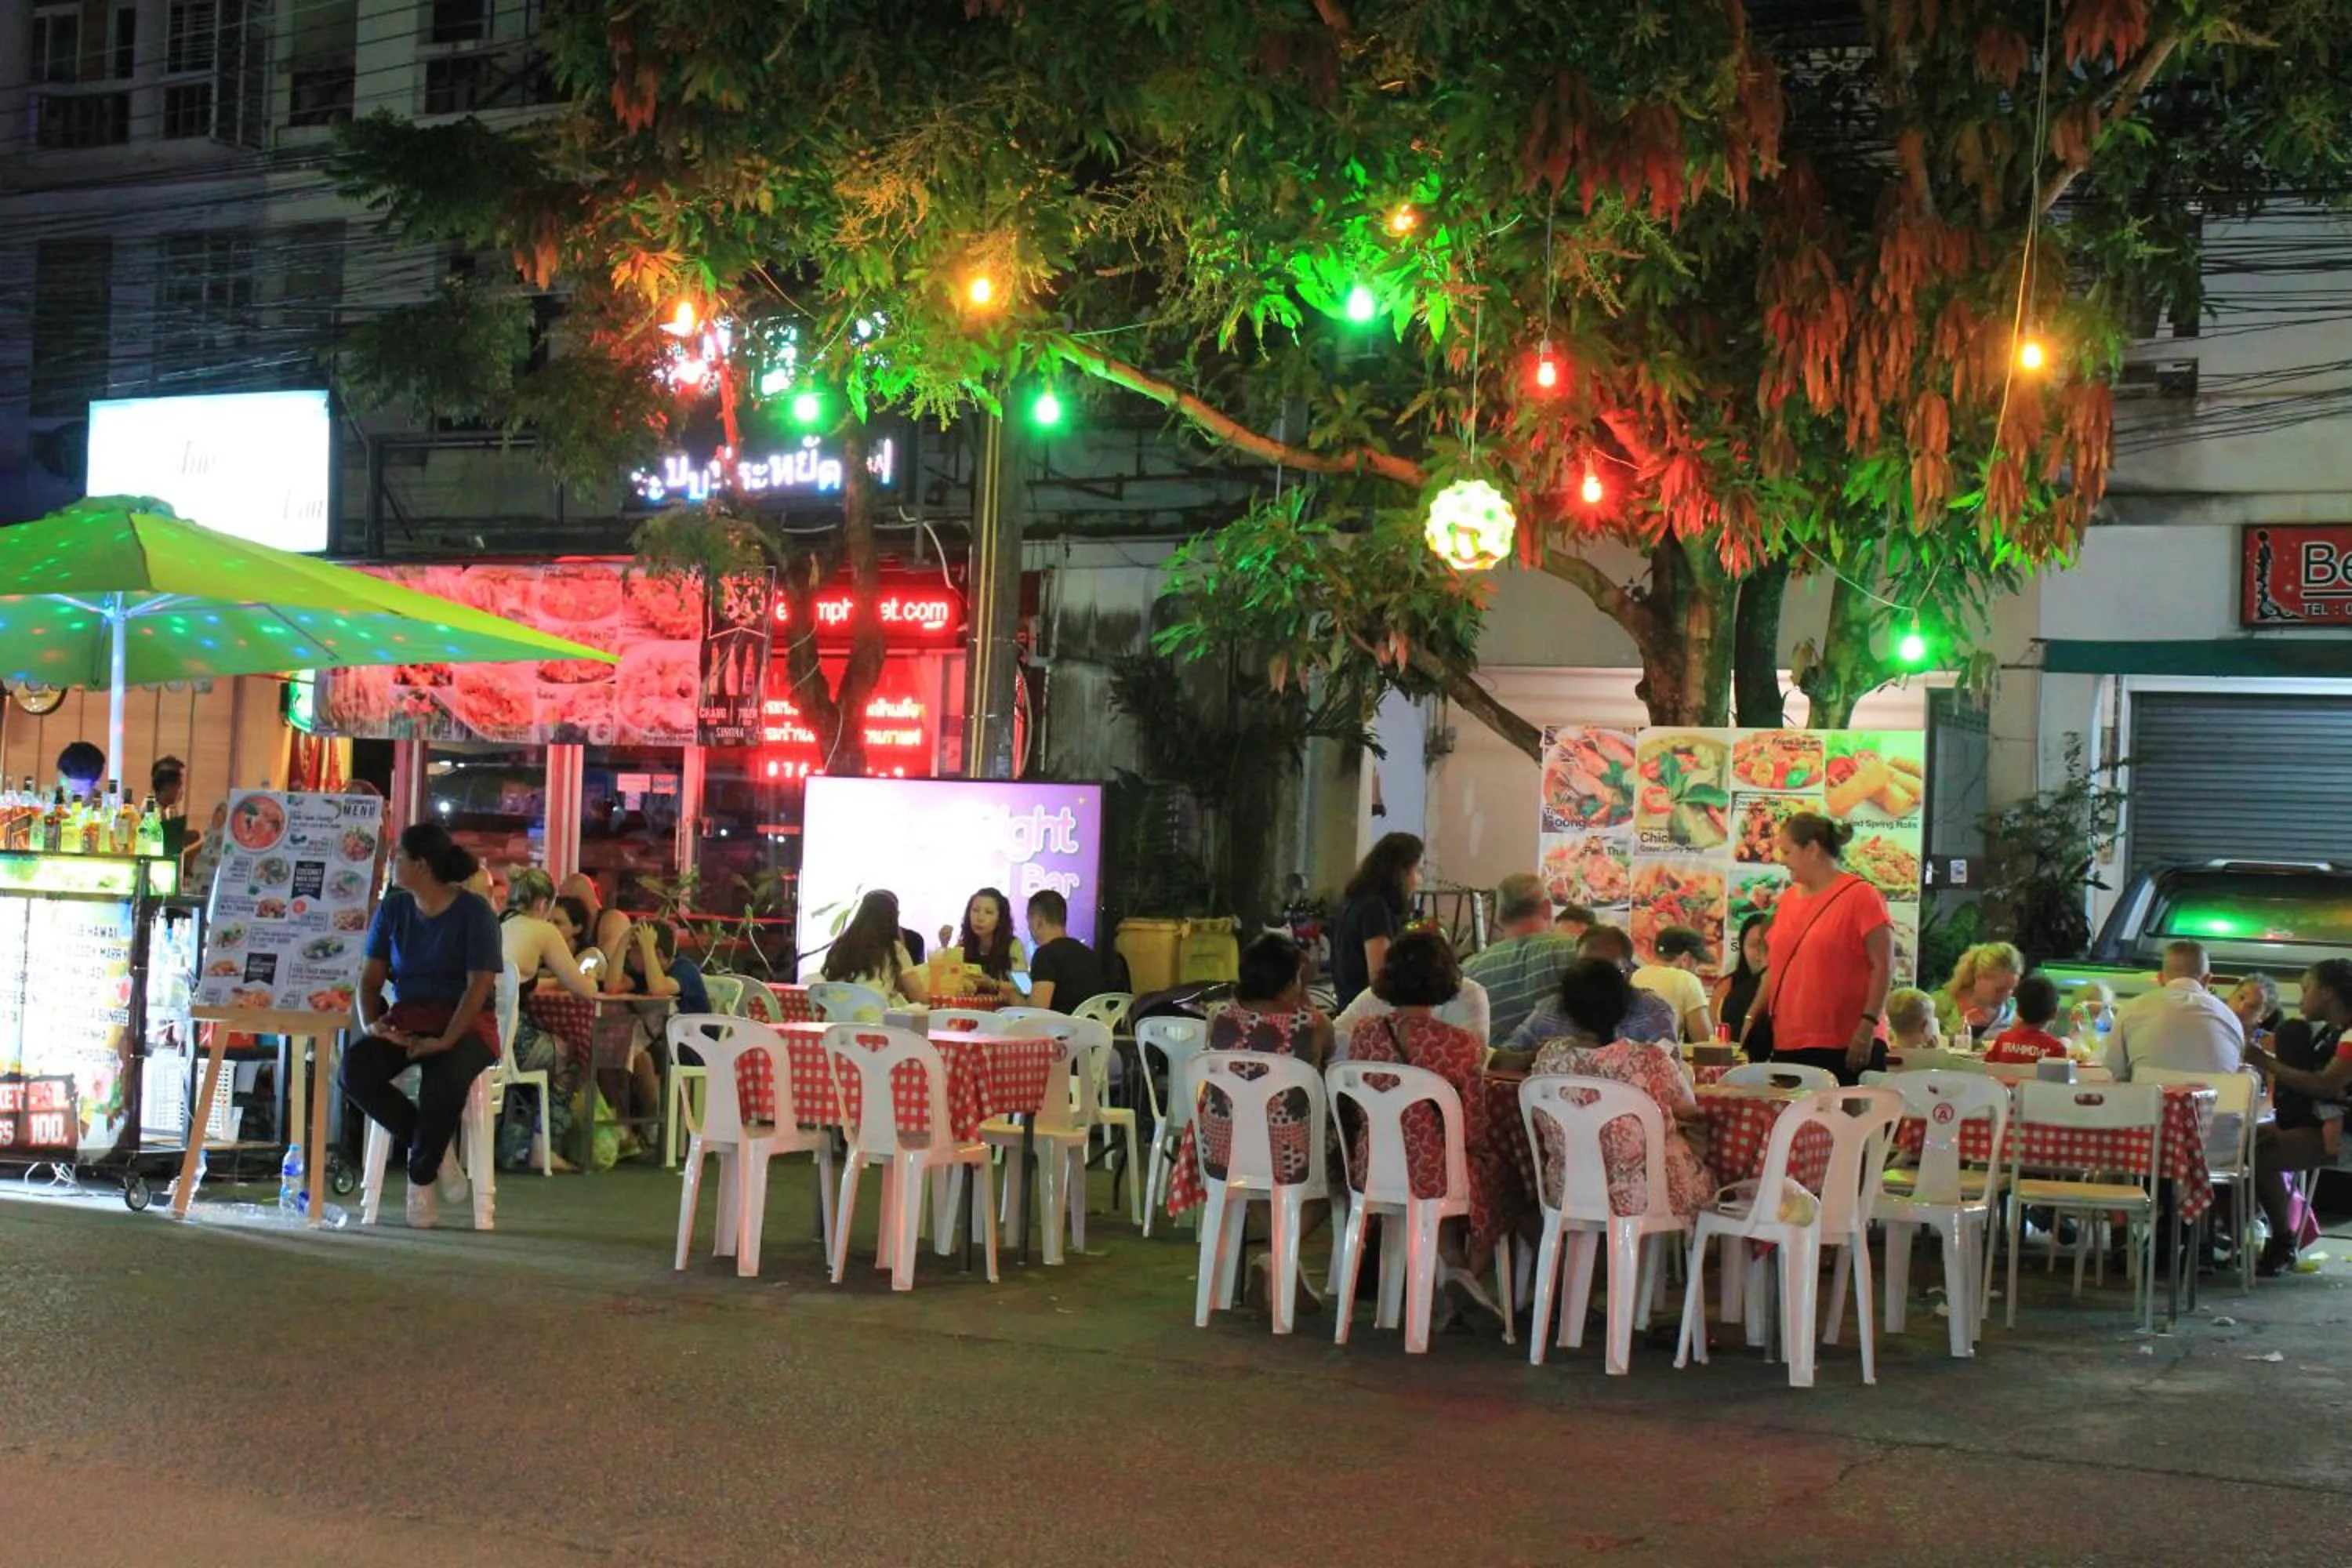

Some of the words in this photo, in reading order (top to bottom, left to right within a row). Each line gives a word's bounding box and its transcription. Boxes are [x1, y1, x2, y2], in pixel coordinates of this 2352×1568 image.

[2302, 603, 2328, 615] TEL
[343, 804, 376, 816] MENU
[1639, 832, 1692, 844] Chicn
